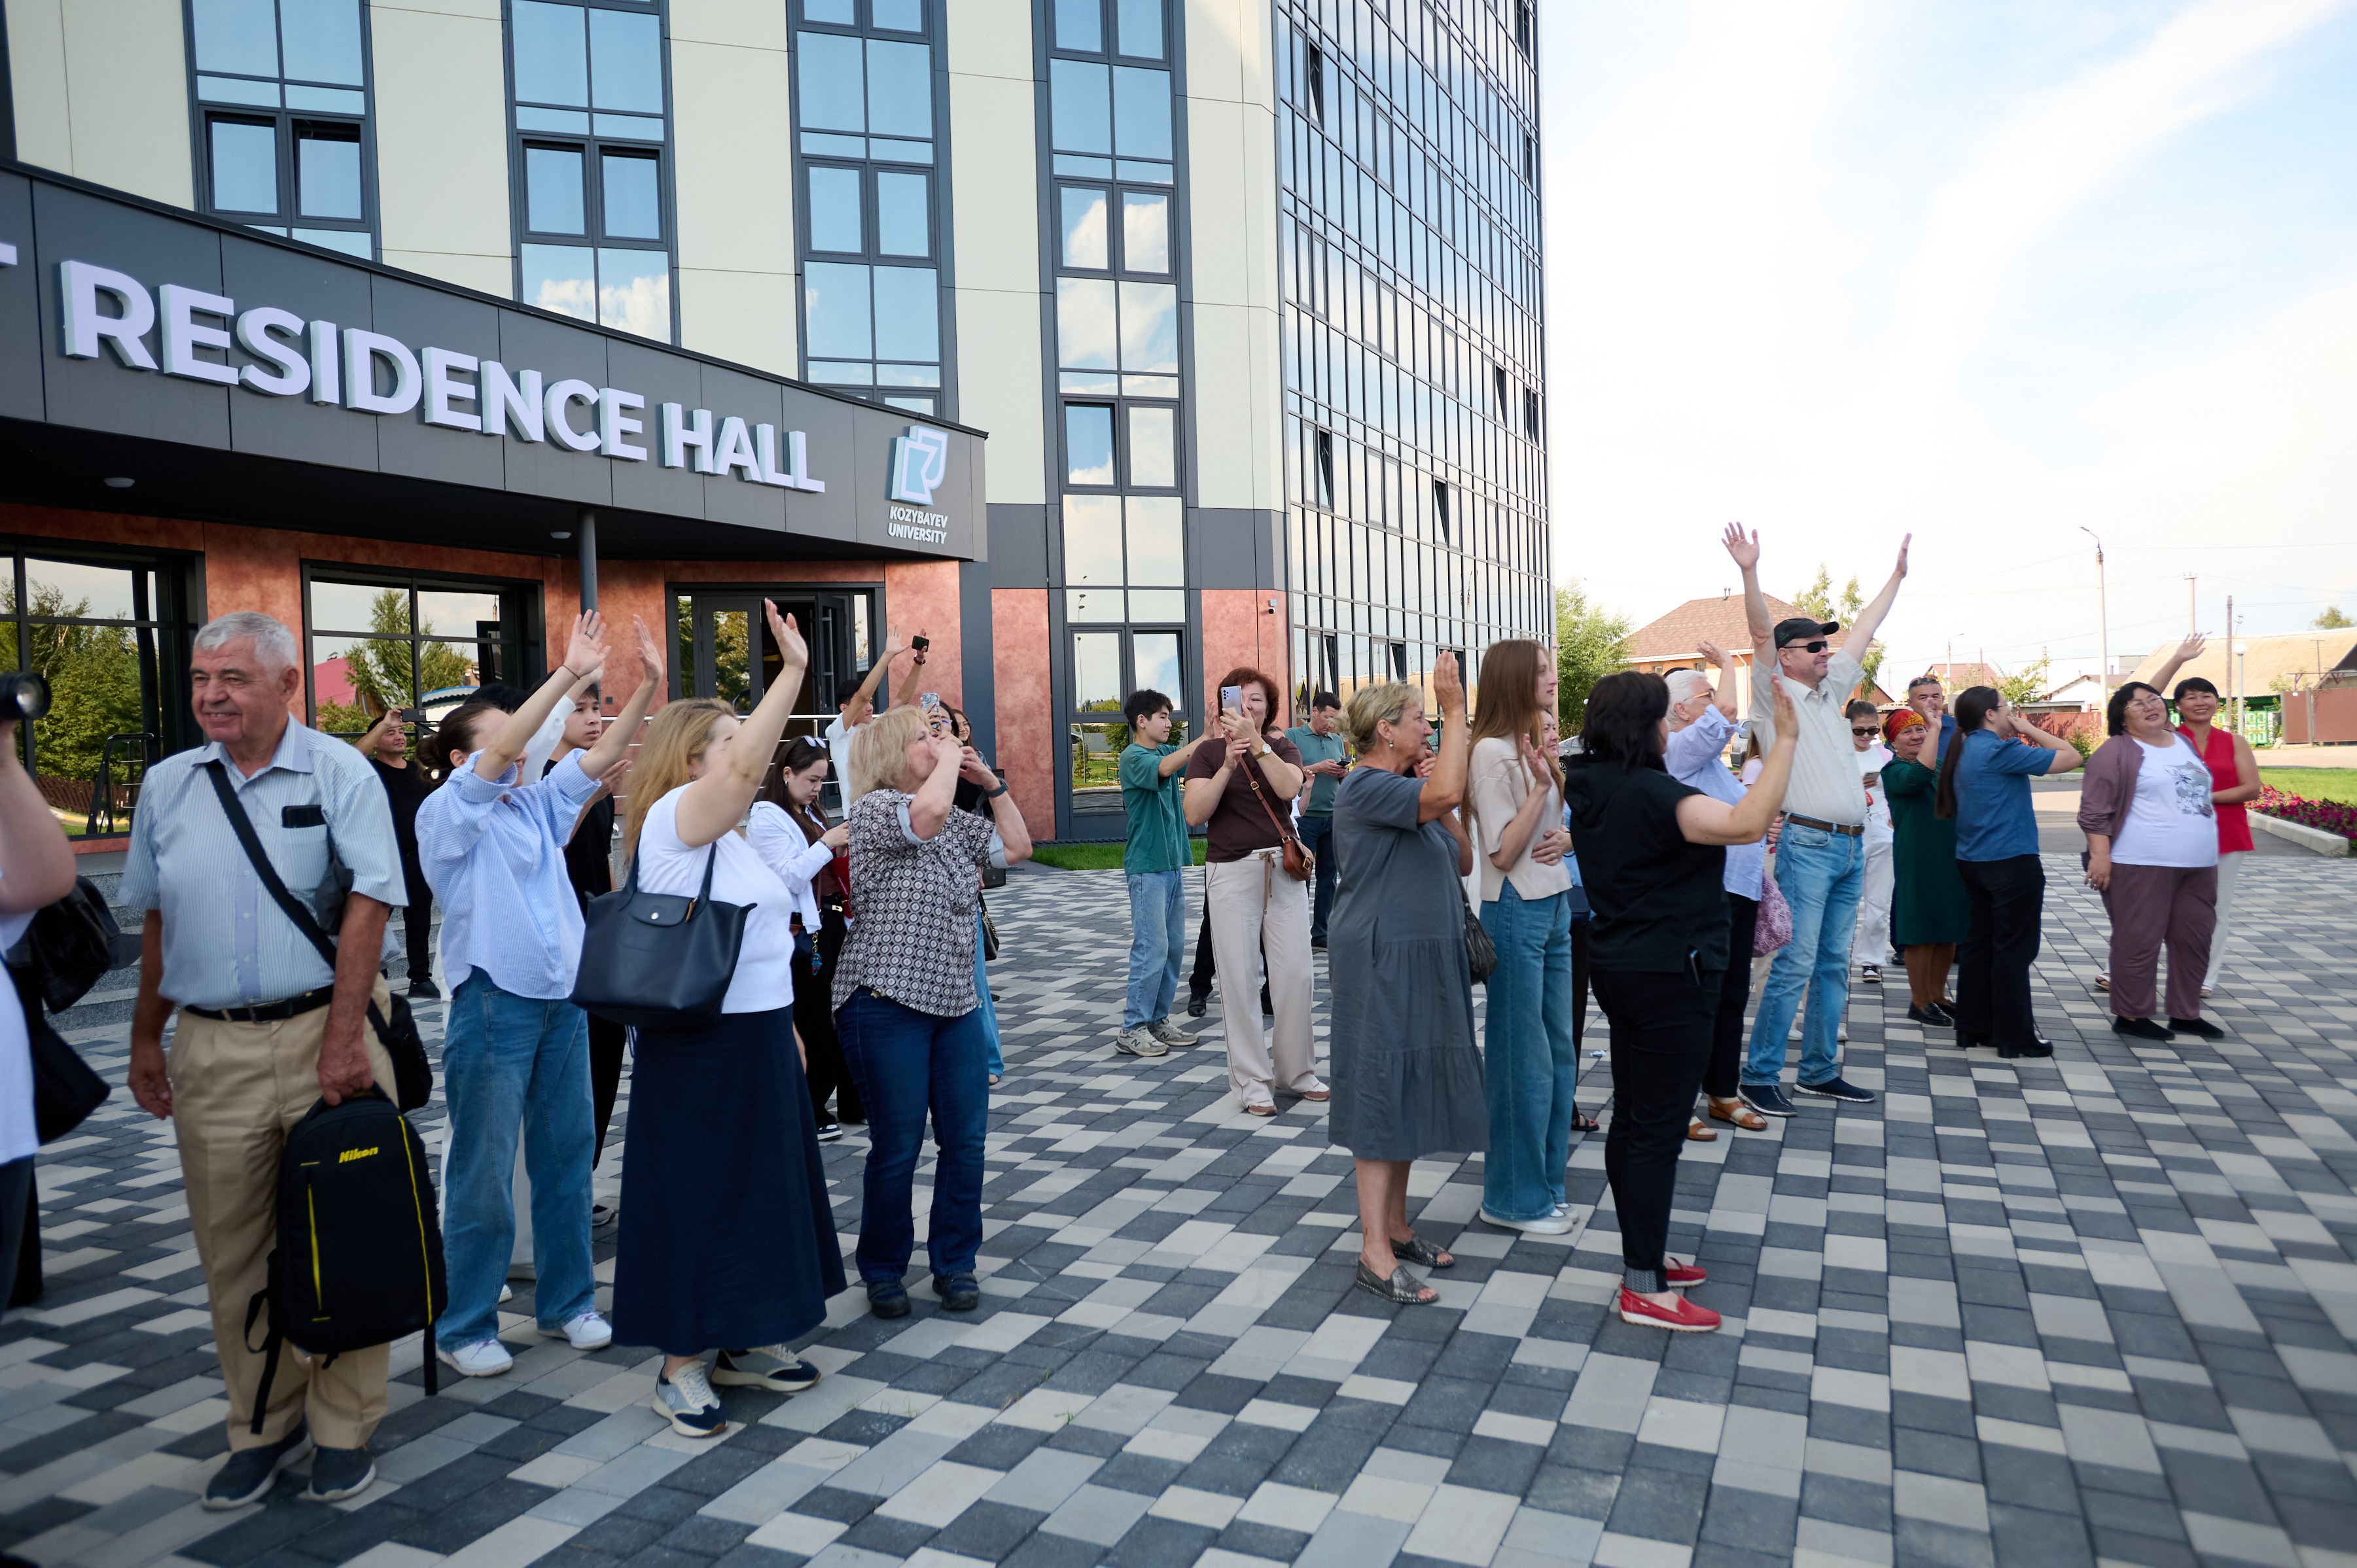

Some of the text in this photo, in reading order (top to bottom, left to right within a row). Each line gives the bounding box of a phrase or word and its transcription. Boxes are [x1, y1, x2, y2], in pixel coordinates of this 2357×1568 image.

[60, 260, 825, 493] RESIDENCE HALL
[889, 506, 948, 528] KOZYBAYEV
[888, 523, 947, 544] UNIVERSITY
[339, 1147, 378, 1163] Nikon
